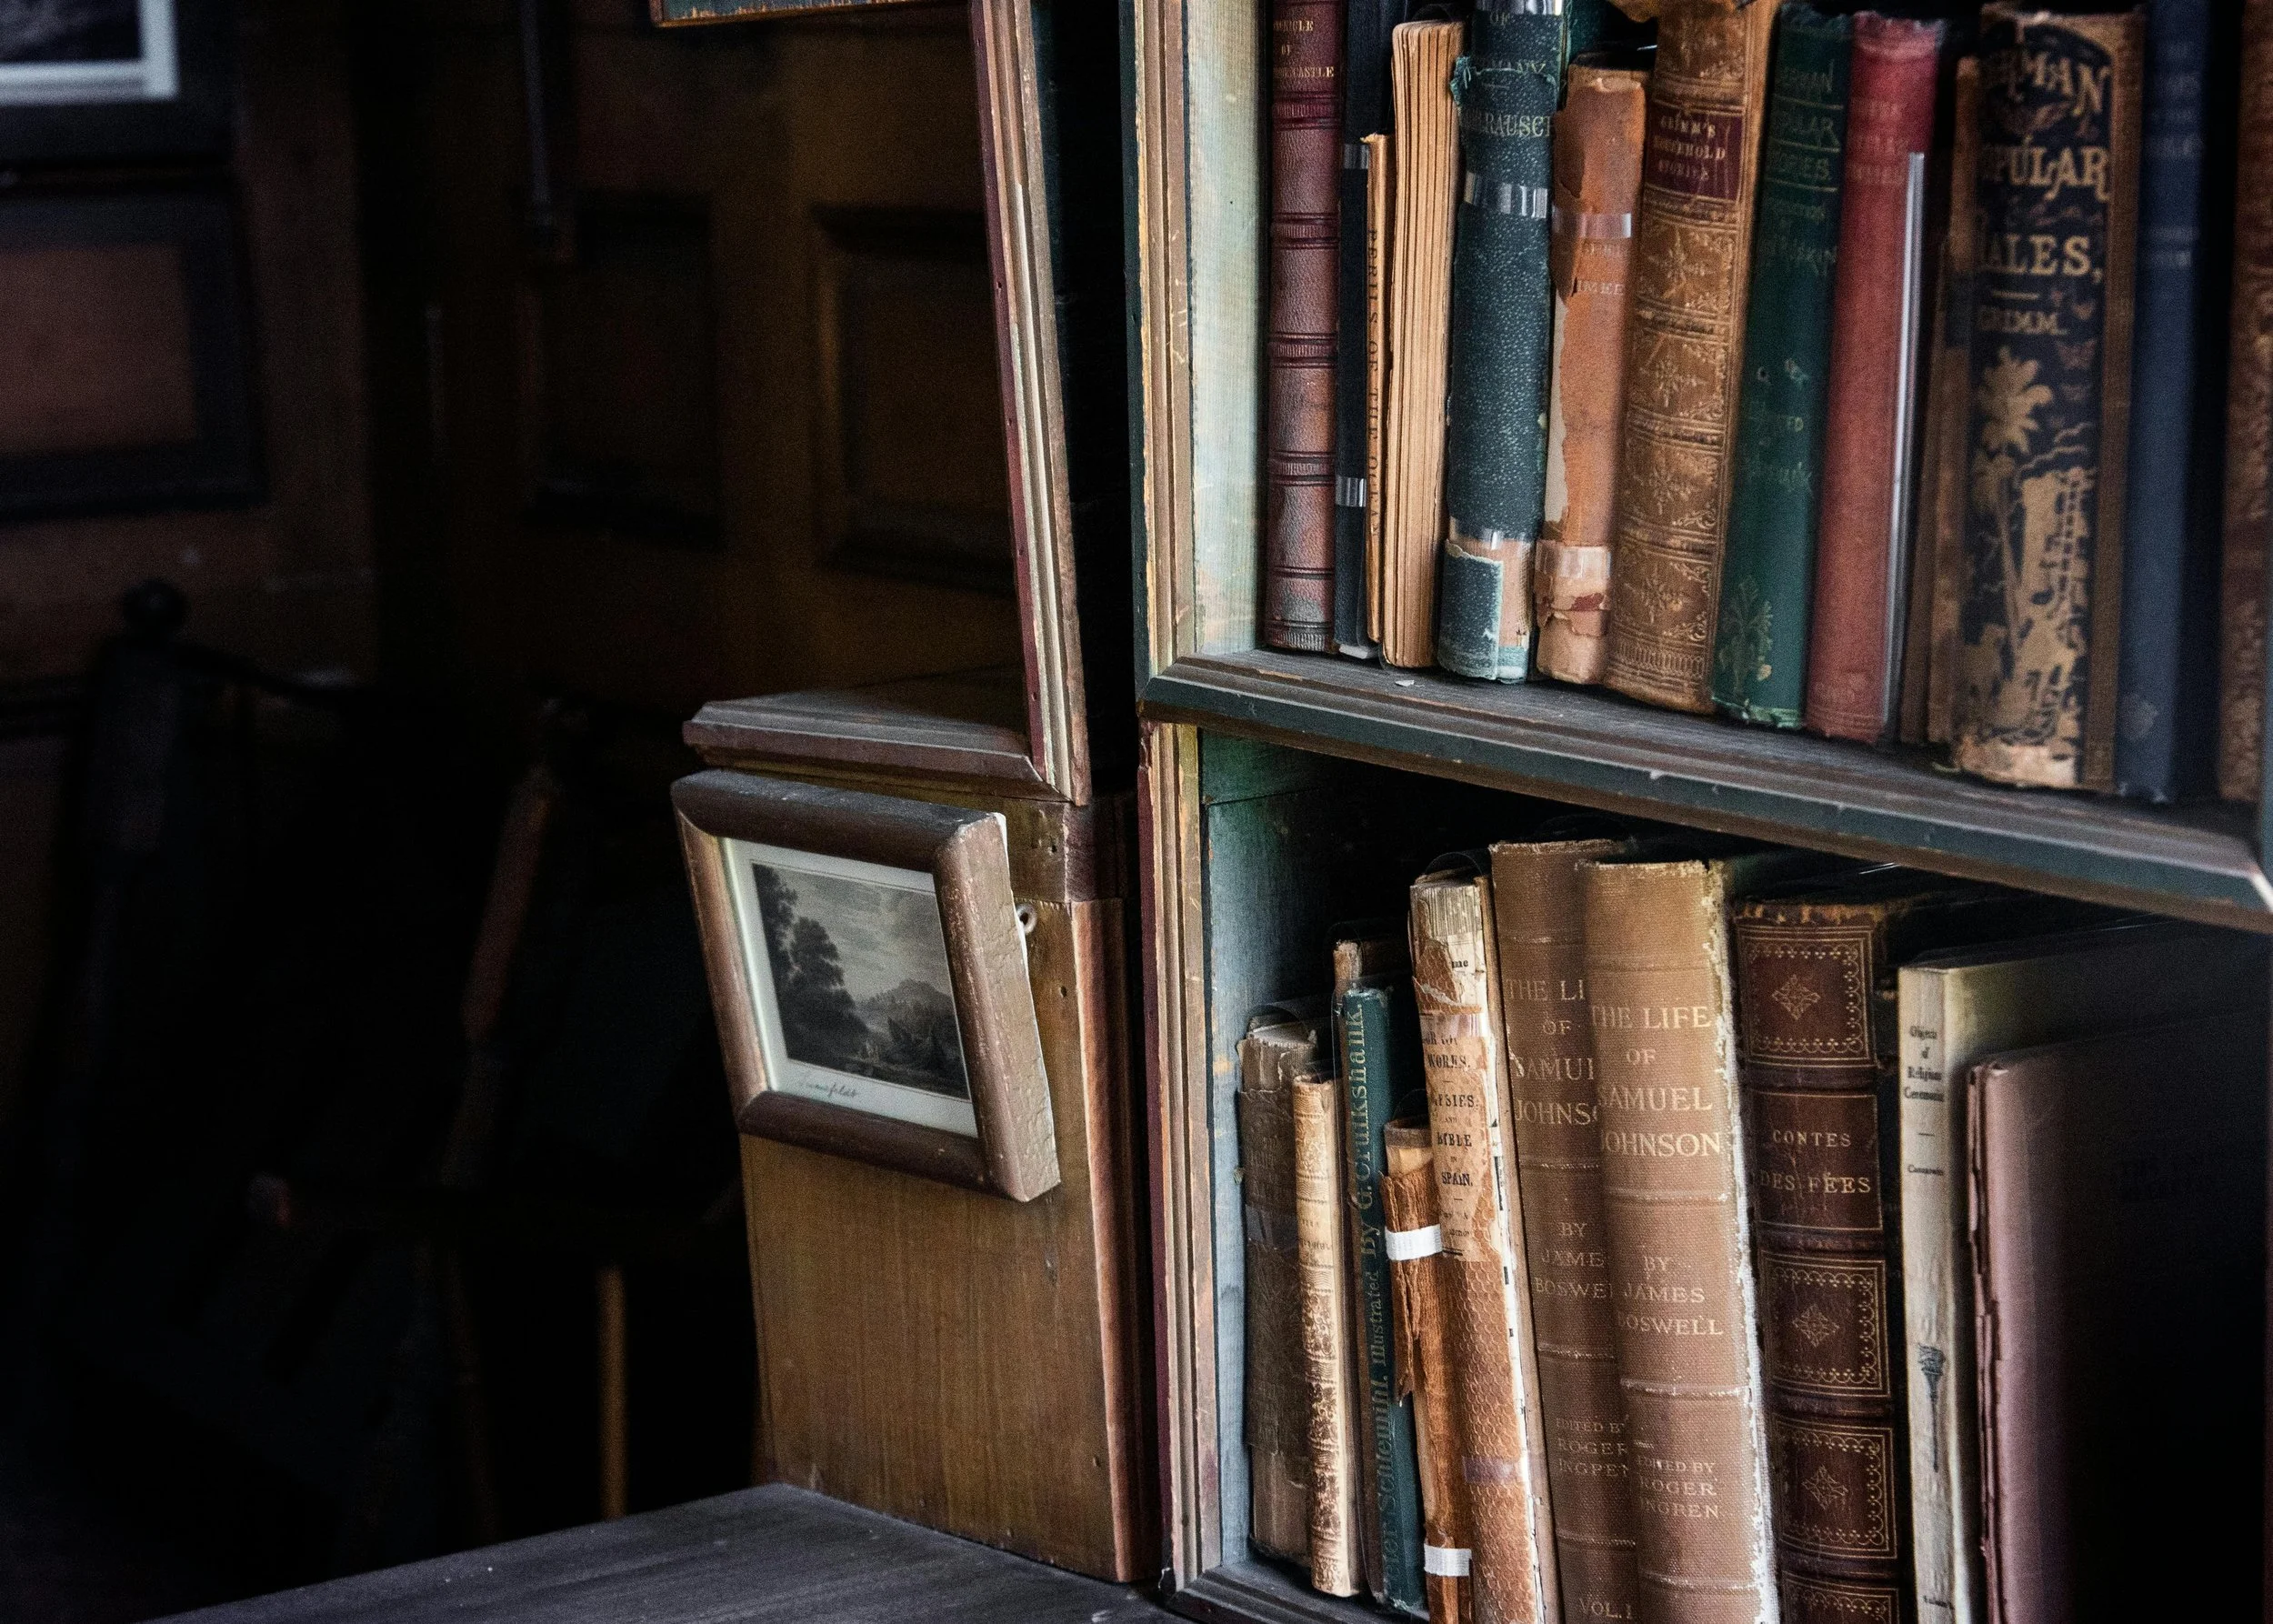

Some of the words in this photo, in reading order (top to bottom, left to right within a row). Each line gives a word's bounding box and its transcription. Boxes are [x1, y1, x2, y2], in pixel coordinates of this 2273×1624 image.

[1367, 339, 1379, 373] OF
[1367, 387, 1379, 440] THE
[1506, 979, 1548, 1002] THE
[1559, 978, 1587, 1002] LI
[1642, 1005, 1713, 1029] LIFE
[1542, 1018, 1573, 1037] OF
[1626, 1048, 1657, 1066] OF
[1597, 1086, 1714, 1112] SAMUEL
[1515, 1099, 1599, 1127] JOHNS
[1773, 1131, 1852, 1148] CONTES
[1441, 1171, 1474, 1187] SPAIN.
[1559, 1222, 1587, 1238] BY
[1541, 1249, 1605, 1268] JAME
[1644, 1255, 1672, 1272] BY
[1624, 1282, 1706, 1304] JAMES
[1609, 1422, 1626, 1434] B
[1692, 1461, 1717, 1474] BY
